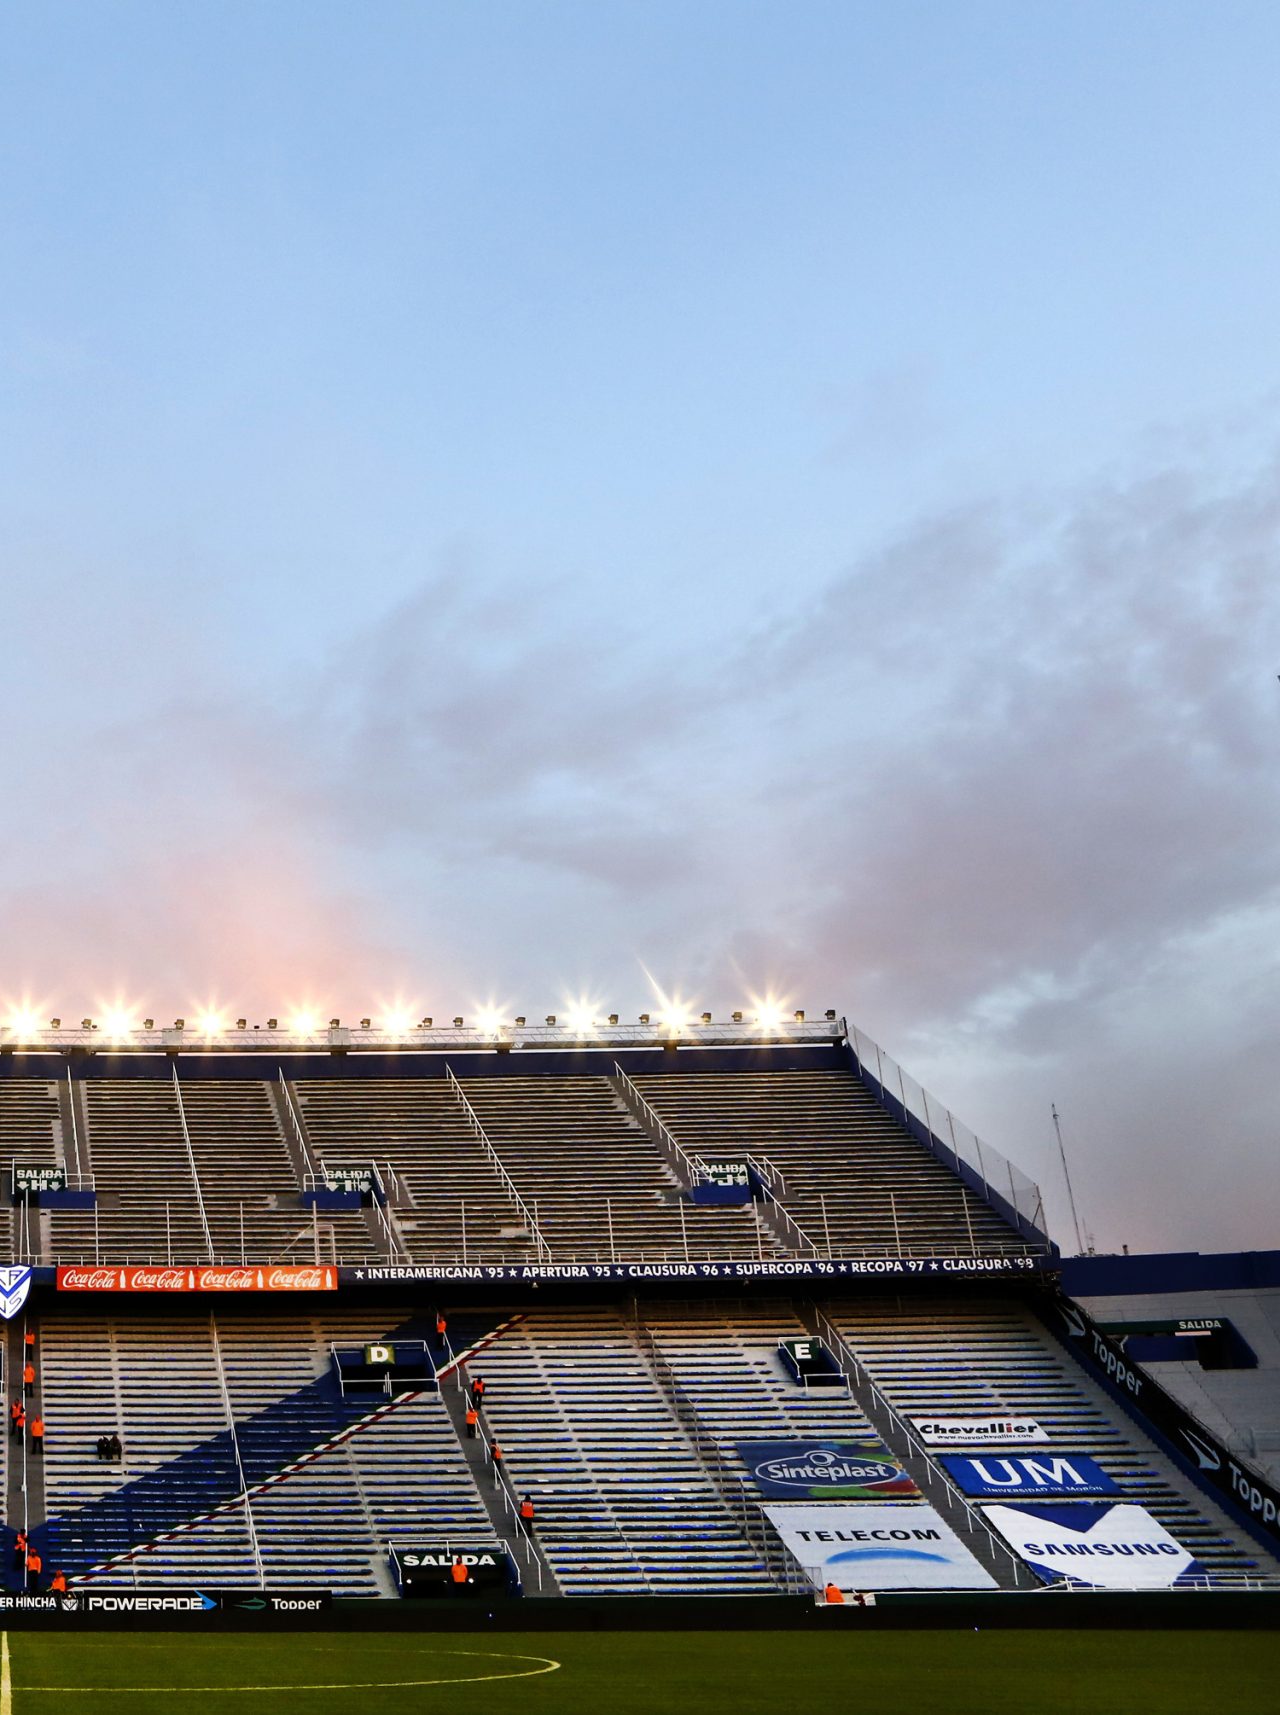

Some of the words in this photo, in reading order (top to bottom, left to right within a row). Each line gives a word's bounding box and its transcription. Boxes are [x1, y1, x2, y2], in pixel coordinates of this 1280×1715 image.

[16, 1169, 63, 1179] SALIDA
[31, 1180, 48, 1190] H
[367, 1266, 483, 1279] INTERAMERICANA
[485, 1267, 504, 1278] '95
[522, 1265, 590, 1278] APERTURA
[592, 1265, 611, 1277] '95
[628, 1264, 697, 1277] CLAUSURA
[699, 1265, 719, 1276] '96
[736, 1262, 813, 1275] SUPERCOPA
[815, 1261, 834, 1273] '96
[851, 1260, 904, 1273] RECOPA
[905, 1260, 924, 1272] '97
[942, 1258, 1012, 1271] CLAUSURA
[62, 1268, 119, 1289] Coca-Cola
[131, 1268, 186, 1290] Coca-Cola
[200, 1268, 254, 1290] Coca-Cola
[268, 1268, 323, 1289] Coca-Cola
[1178, 1319, 1222, 1330] SALIDA
[370, 1346, 389, 1362] D
[794, 1343, 812, 1359] E
[1091, 1329, 1144, 1397] Topper
[919, 1422, 1038, 1434] Chevallier
[767, 1463, 889, 1482] Sinteplast
[966, 1458, 1088, 1486] UM
[1228, 1461, 1280, 1529] Topp
[795, 1529, 942, 1542] TELECOM
[1023, 1543, 1180, 1556] SAMSUNG
[403, 1554, 496, 1566] SALIDA
[15, 1596, 57, 1608] HINCHA
[88, 1597, 204, 1611] POWERADE
